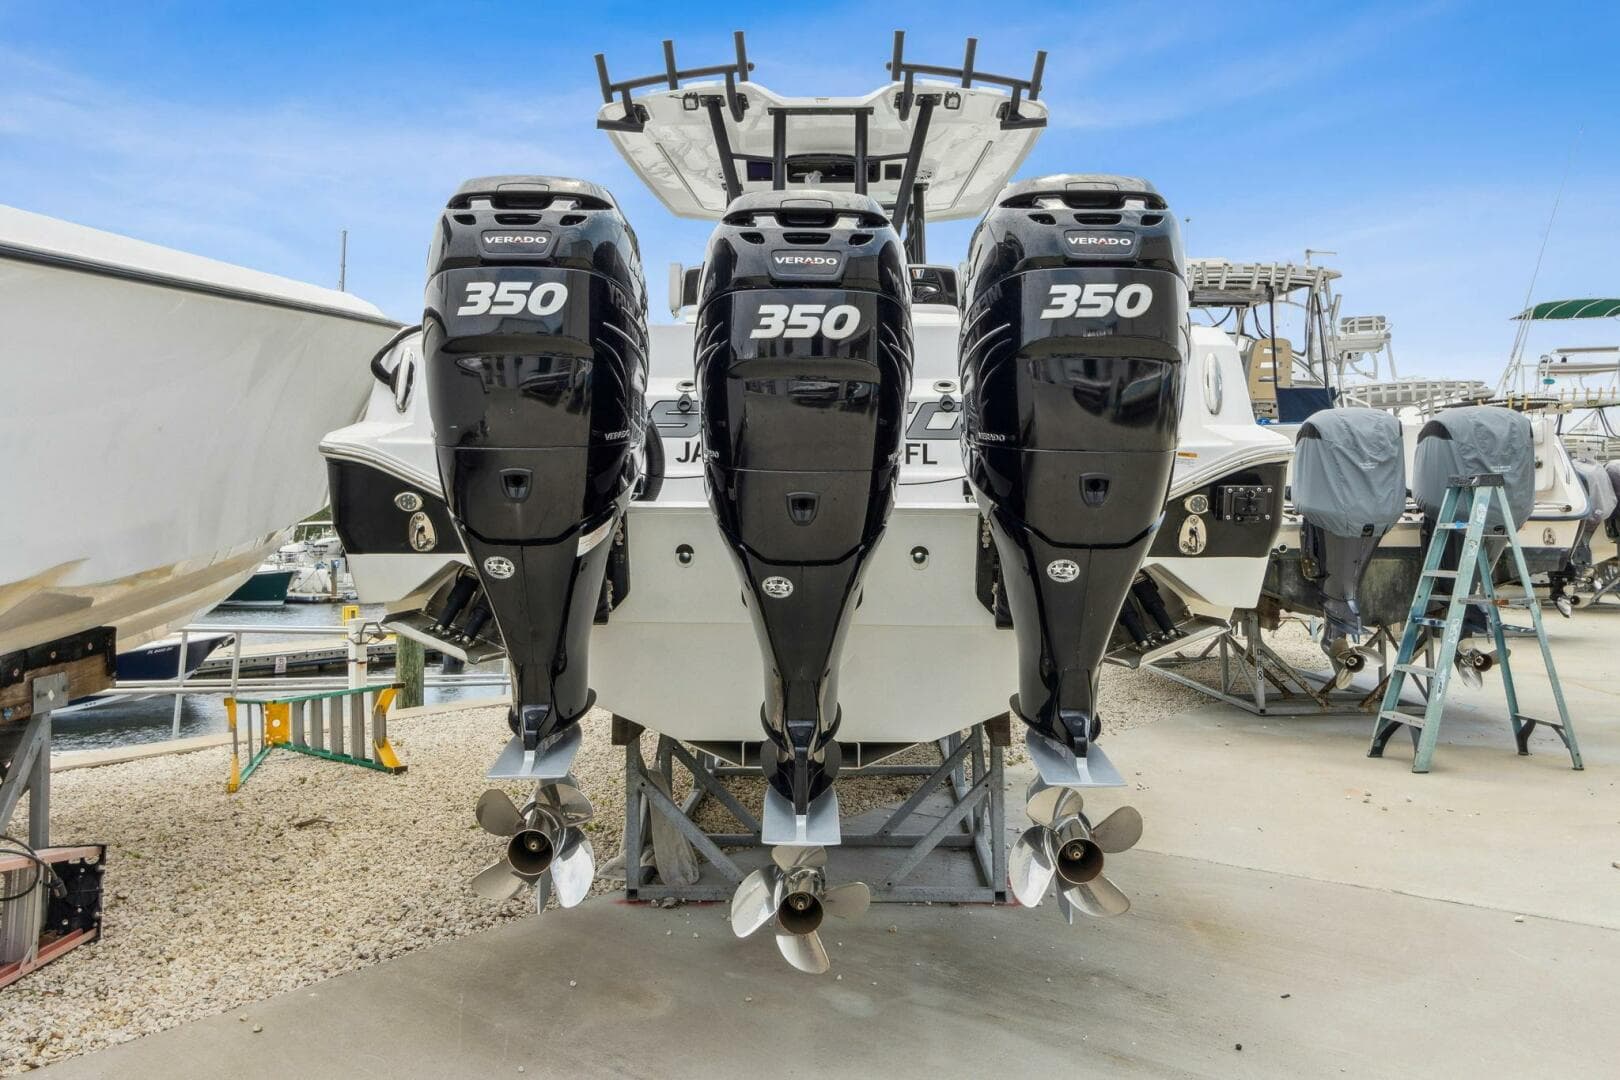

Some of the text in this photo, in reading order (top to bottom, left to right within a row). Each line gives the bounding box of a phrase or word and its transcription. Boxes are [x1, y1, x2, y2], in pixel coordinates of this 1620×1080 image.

[484, 235, 548, 245] VERADO
[1068, 236, 1132, 246] VERADO
[774, 255, 838, 266] VERADO
[457, 281, 568, 316] 350
[1040, 283, 1153, 320] 350
[750, 304, 861, 340] 350
[675, 441, 702, 463] JA
[905, 442, 938, 465] FL
